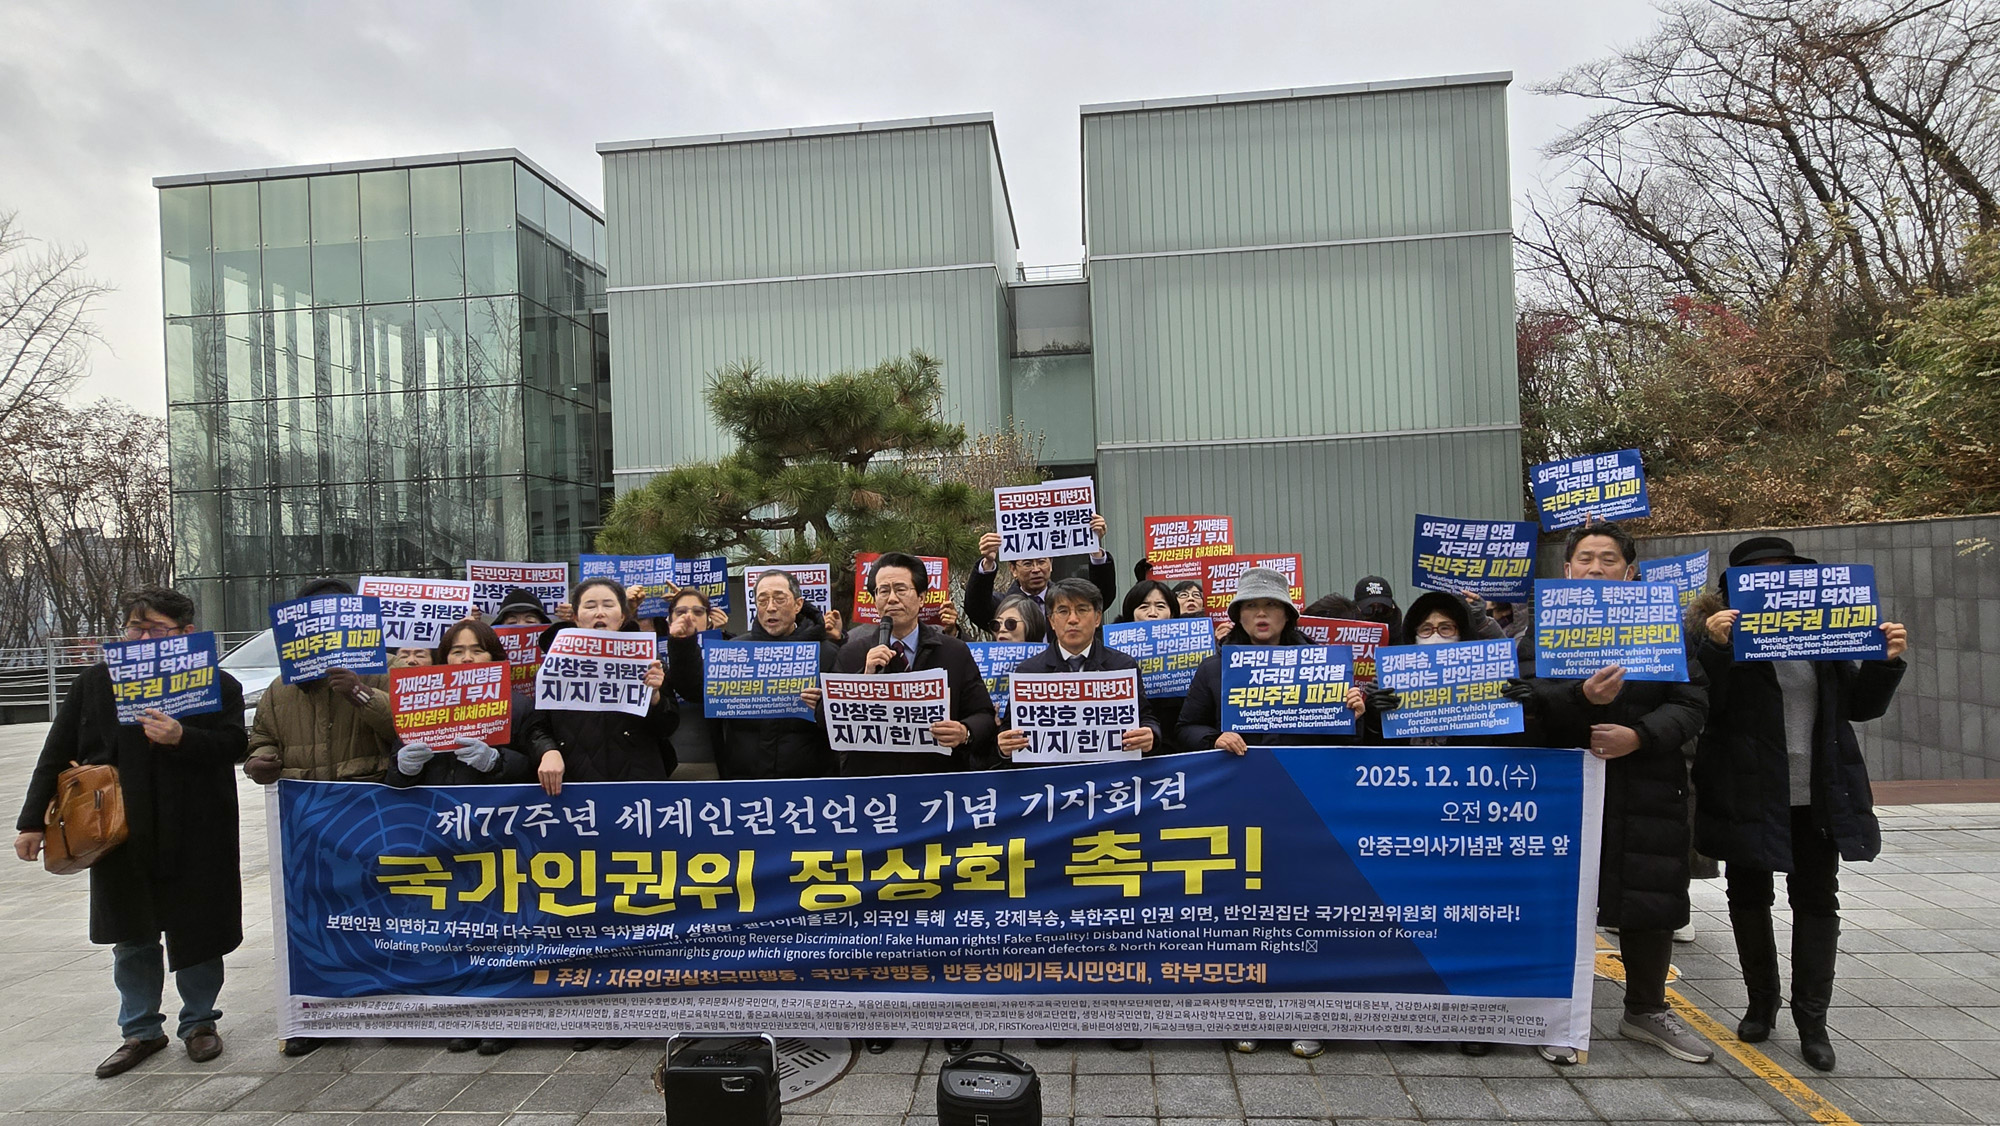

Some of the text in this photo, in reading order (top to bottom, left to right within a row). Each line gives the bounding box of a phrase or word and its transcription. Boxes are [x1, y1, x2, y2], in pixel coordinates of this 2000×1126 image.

[1538, 454, 1619, 483] 외국인 특별 인권
[1555, 465, 1636, 493] 자국민 역차별
[1000, 487, 1091, 509] 국민인권 대변자
[1542, 479, 1641, 512] 국민주권 파괴!
[1001, 508, 1093, 532] 안창호 위원장
[1150, 519, 1228, 536] 가짜인권, 가짜평등
[1003, 530, 1094, 553] 지/지/한/다!
[1153, 532, 1228, 549] 보편인권 무시
[1421, 523, 1516, 540] 외국인 특별 인권
[1148, 545, 1233, 562] 국가인권위 해체하라!
[1437, 540, 1530, 558] 자국민 역차별
[1418, 554, 1531, 578] 국민주권 파괴!
[1738, 566, 1850, 592] 외국인 특별 인권
[365, 583, 468, 601] 국민인권 대변자
[1541, 586, 1673, 608] 강제북송, 북한주민 인권
[1763, 586, 1870, 610] 자국민 역차별
[277, 596, 363, 625] 외국인 특별 인권
[421, 605, 468, 620] 위원장
[1540, 606, 1677, 626] 외면하는 반인권집단
[1740, 605, 1877, 634] 국민주권 파괴!
[295, 613, 376, 638] 자국민 역차별
[1539, 624, 1679, 648] 국가인권위 규탄한다!
[126, 637, 188, 661] 특별 인권
[282, 629, 381, 661] 국민주권 파괴!
[605, 640, 653, 657] 대변자
[1753, 631, 1872, 645] Violating Popular Sovereignty!
[1761, 639, 1862, 652] Privileging Non-Nationals!
[160, 651, 208, 673] 역차별
[708, 644, 816, 663] 강제북송, 북한주민 인권
[1230, 647, 1327, 667] 외국인 특별 인권
[1382, 643, 1511, 673] 강제북송, 북한주민 인권
[1541, 648, 1682, 659] We condemn NHRC which ignores
[1745, 644, 1881, 659] Promoting Reverse Discrimination!
[543, 659, 599, 677] 안창호
[707, 661, 817, 679] 외면하는 반인권집단
[1249, 664, 1345, 685] 자국민 역차별
[1442, 662, 1515, 684] 반인권집단
[169, 666, 213, 693] 파괴!
[395, 665, 503, 695] 가짜인권, 가짜평등
[706, 681, 763, 696] 국가인권위
[828, 681, 942, 700] 국민인권 대변자
[1016, 680, 1132, 700] 국민인권 대변자
[399, 683, 500, 711] 보편인권 무시
[1228, 686, 1300, 707] 국민주권
[1305, 682, 1349, 703] 파괴!
[395, 701, 508, 727] 국가인권위 해체하라!
[830, 703, 945, 724] 안창호 위원장
[1017, 705, 1135, 727] 안창호 위원장
[1356, 763, 1537, 790] 2025. 12. 10.(수)
[436, 771, 1187, 842] 제77주년 세계인권선언일 기념 기자회견
[1441, 801, 1538, 824] 오전 9:40
[1358, 834, 1571, 857] 안중근의사기념관 정문 앞
[375, 825, 1262, 917] 국가인권위 정상화 촉구!
[326, 904, 1521, 940] 보편인권 외면하고 자국민과 다수국민 인권 역차별하며, 외국인 특혜 선동, 강제북송, 북한주민 인권 외면, 반인권집단 국가인권위원회 해체하라!
[796, 926, 1438, 947] Discrimination! Human National Rights Commission Korea!
[606, 961, 1267, 988] 자유인권실천국민행동, 국민주권행동, 반동성애기독시민연대, 학부모단체
